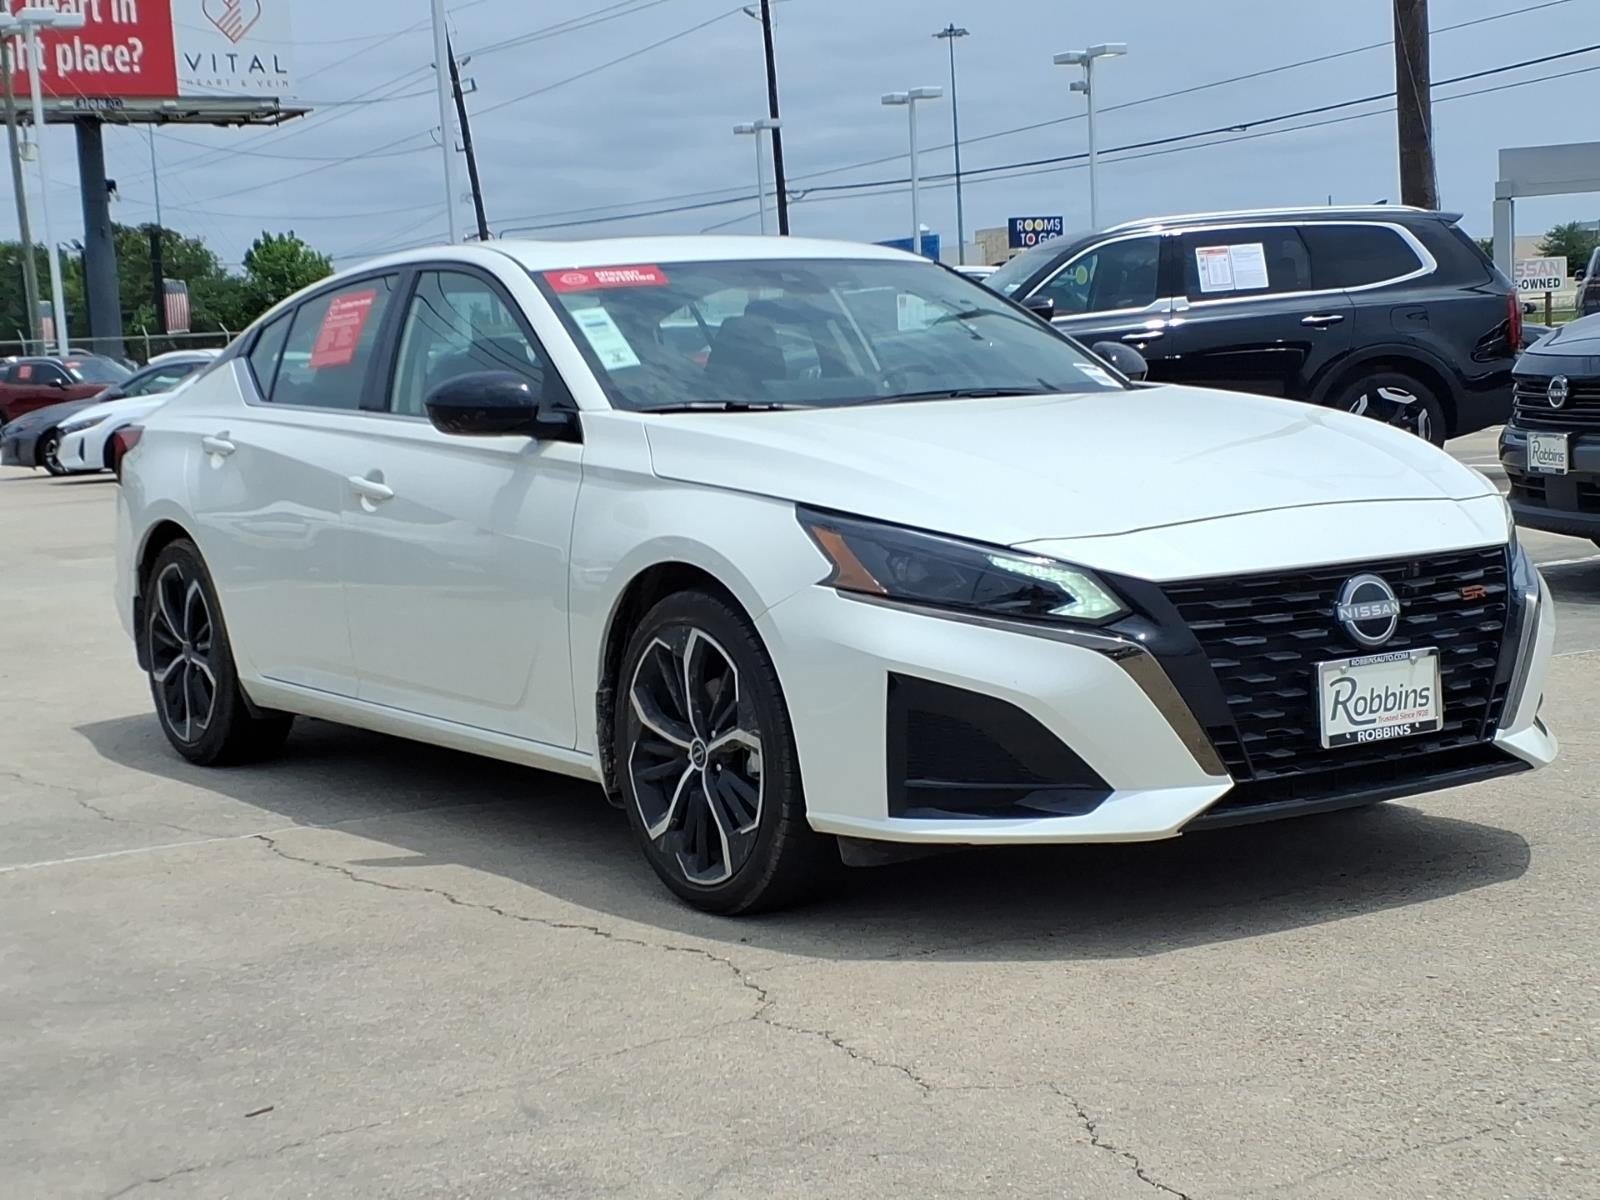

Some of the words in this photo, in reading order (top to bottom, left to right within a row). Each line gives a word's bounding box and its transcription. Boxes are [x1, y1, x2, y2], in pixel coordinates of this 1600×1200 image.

[25, 0, 102, 23] art
[111, 0, 138, 23] in
[56, 36, 144, 77] place?
[184, 52, 287, 74] VITAL
[1016, 218, 1061, 231] ROOMS
[1020, 232, 1036, 246] TO
[1514, 277, 1561, 290] -OWNED
[1531, 440, 1565, 465] Robbins
[1461, 584, 1488, 600] SR
[1339, 601, 1399, 618] NISSAN
[1329, 676, 1430, 726] Robbins
[1357, 724, 1411, 742] ROBBINS
